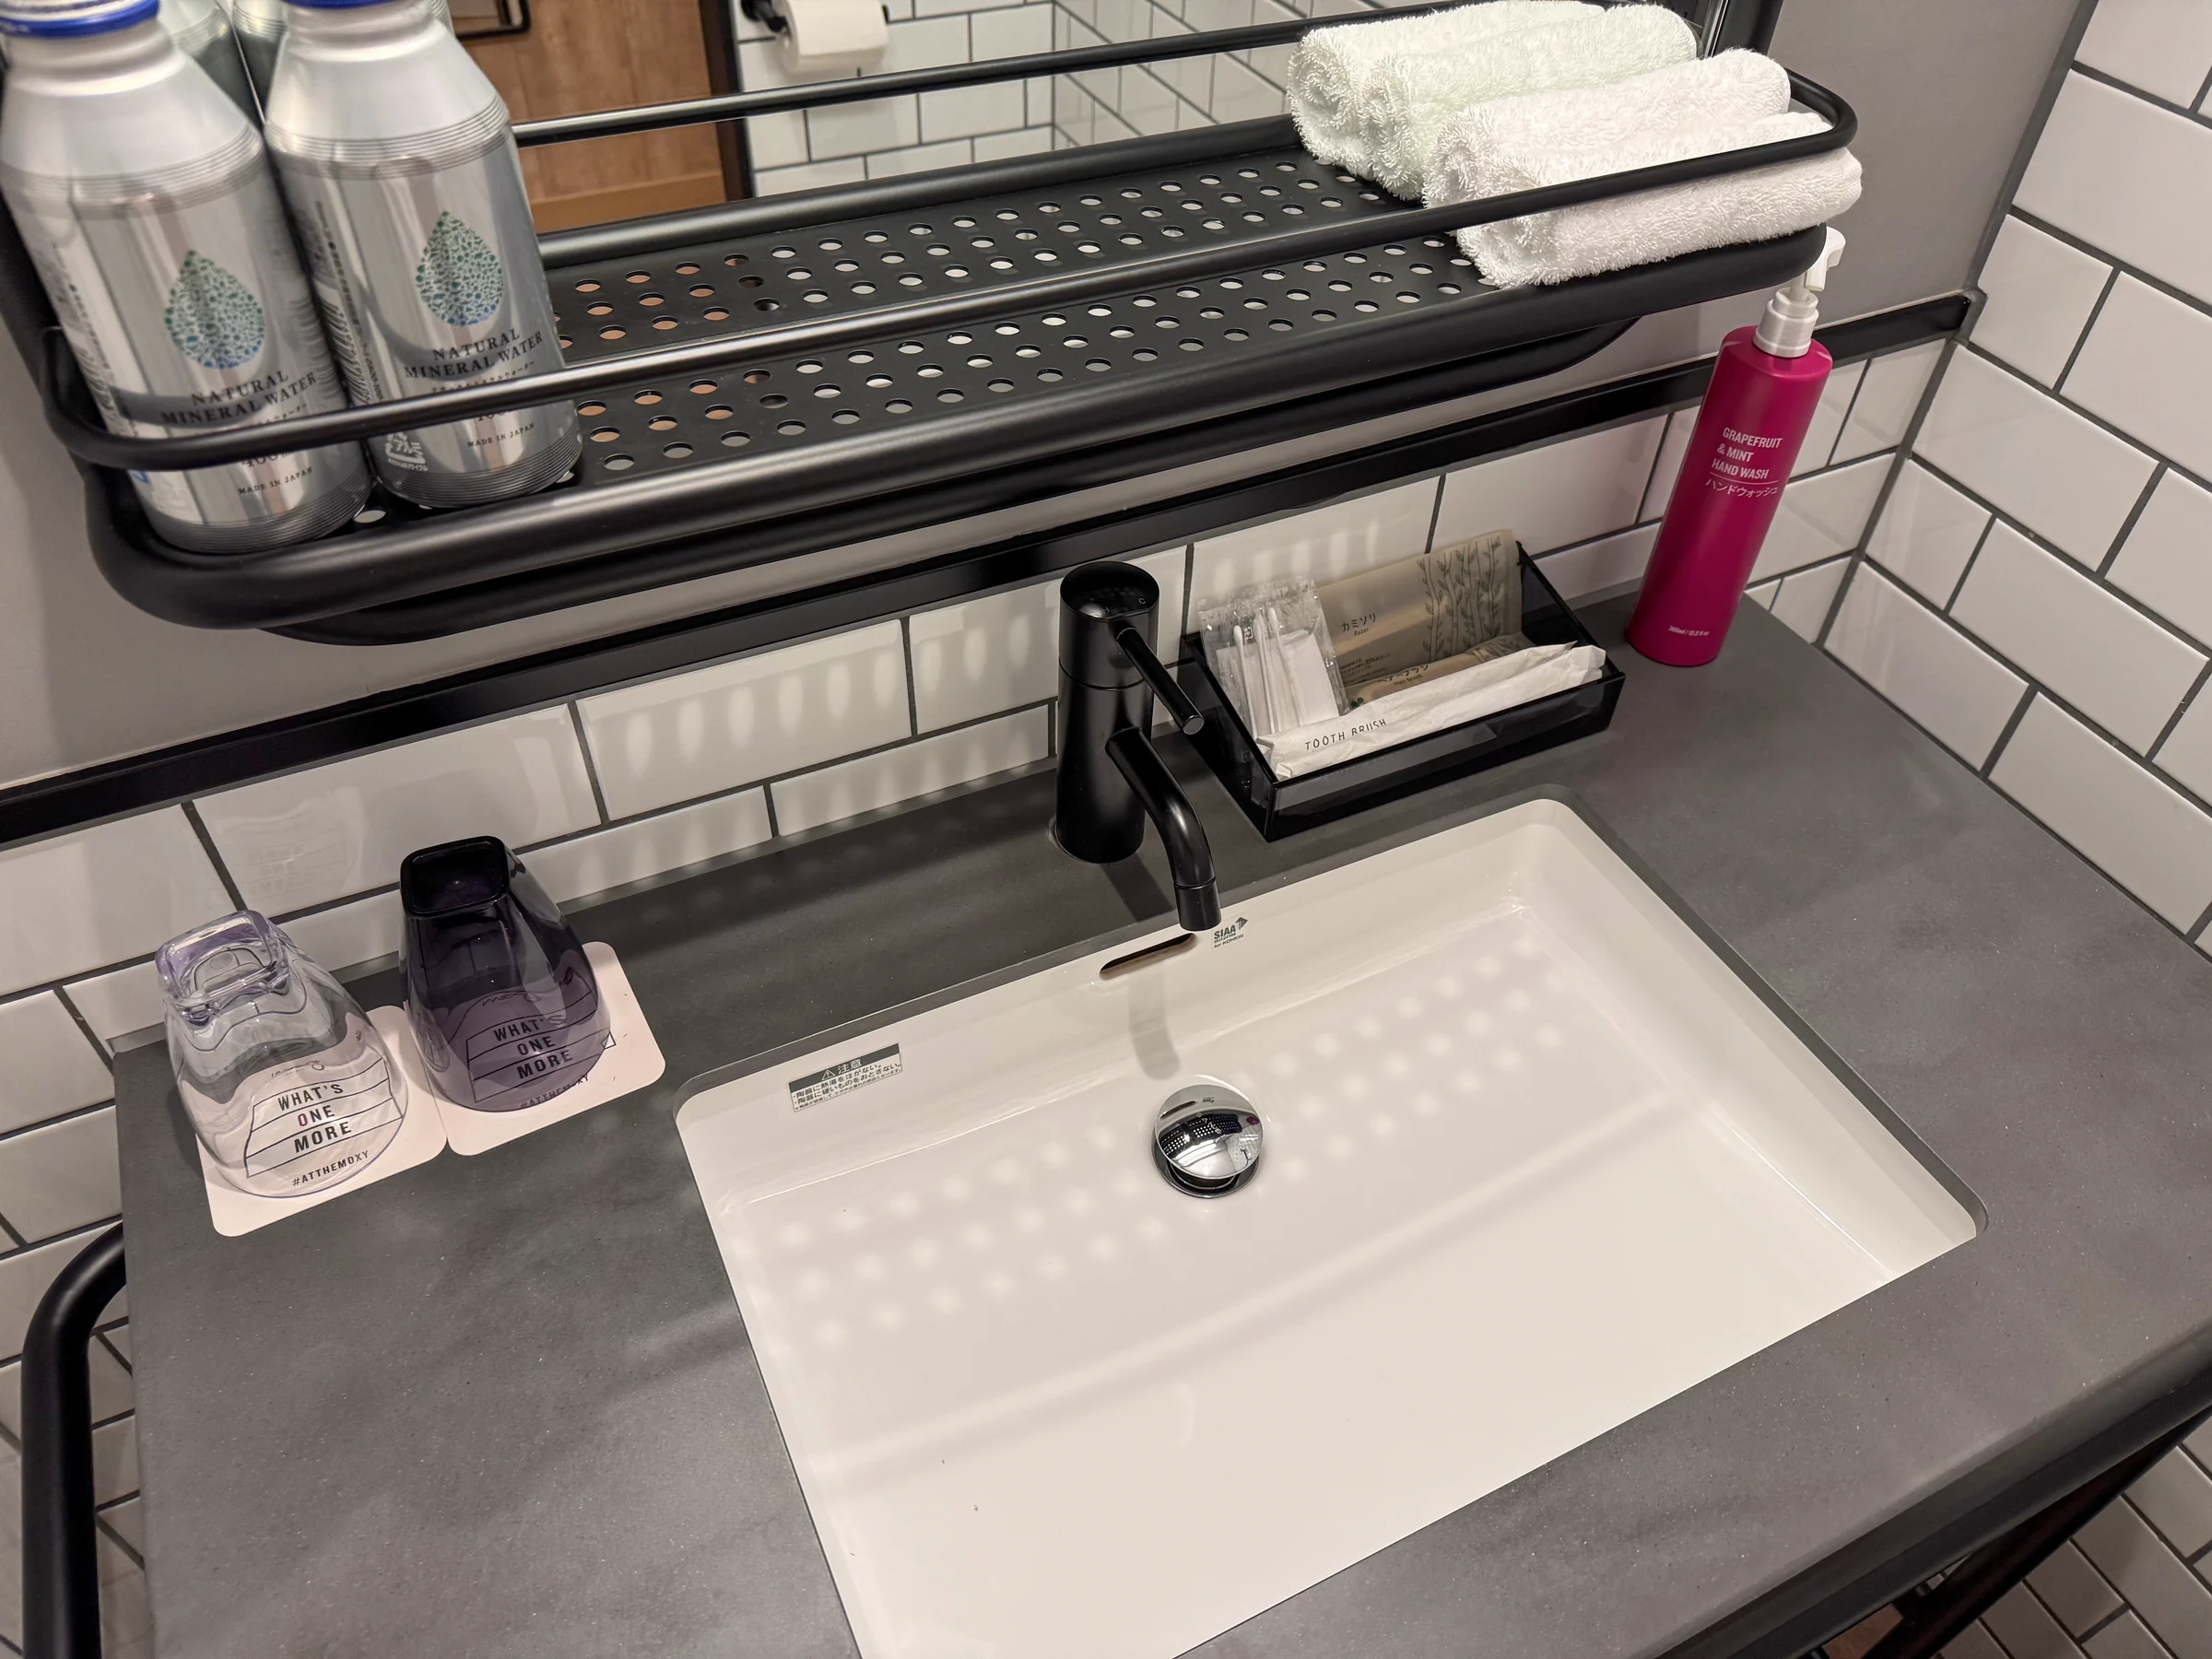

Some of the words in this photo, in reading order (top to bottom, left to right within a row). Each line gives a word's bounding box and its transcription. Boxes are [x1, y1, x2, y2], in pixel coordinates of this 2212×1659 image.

[405, 357, 495, 380] MINERAL
[499, 331, 543, 363] WATER
[433, 328, 520, 362] NATURAL
[162, 400, 263, 425] MINERAL
[265, 371, 318, 406] WATER
[192, 371, 288, 406] NATURAL
[467, 436, 493, 448] MADE
[497, 434, 506, 442] IN
[510, 422, 535, 438] JAPAN
[1722, 427, 1783, 449] GRAPEFRUIT
[1717, 443, 1725, 455] &
[1726, 447, 1755, 463] MINT
[1712, 458, 1739, 477] HAND
[1739, 467, 1770, 480] WASH
[239, 483, 265, 495] MADE
[269, 478, 280, 488] IN
[285, 466, 312, 484] JAPAN
[1342, 612, 1377, 632] カミソリ
[1354, 627, 1370, 637] Razor
[1393, 677, 1406, 687] Hair
[1406, 674, 1424, 685] brush
[1304, 731, 1346, 751] TOOTH
[1214, 924, 1237, 940] SIAA
[517, 1035, 556, 1055] ONE
[516, 1049, 573, 1079] MORE
[838, 1058, 863, 1075] 注意
[277, 1084, 344, 1112] WHAT'S
[297, 1105, 335, 1127] ONE
[294, 1121, 352, 1153] MORE
[291, 1150, 369, 1187] #ATTHEMOXY
